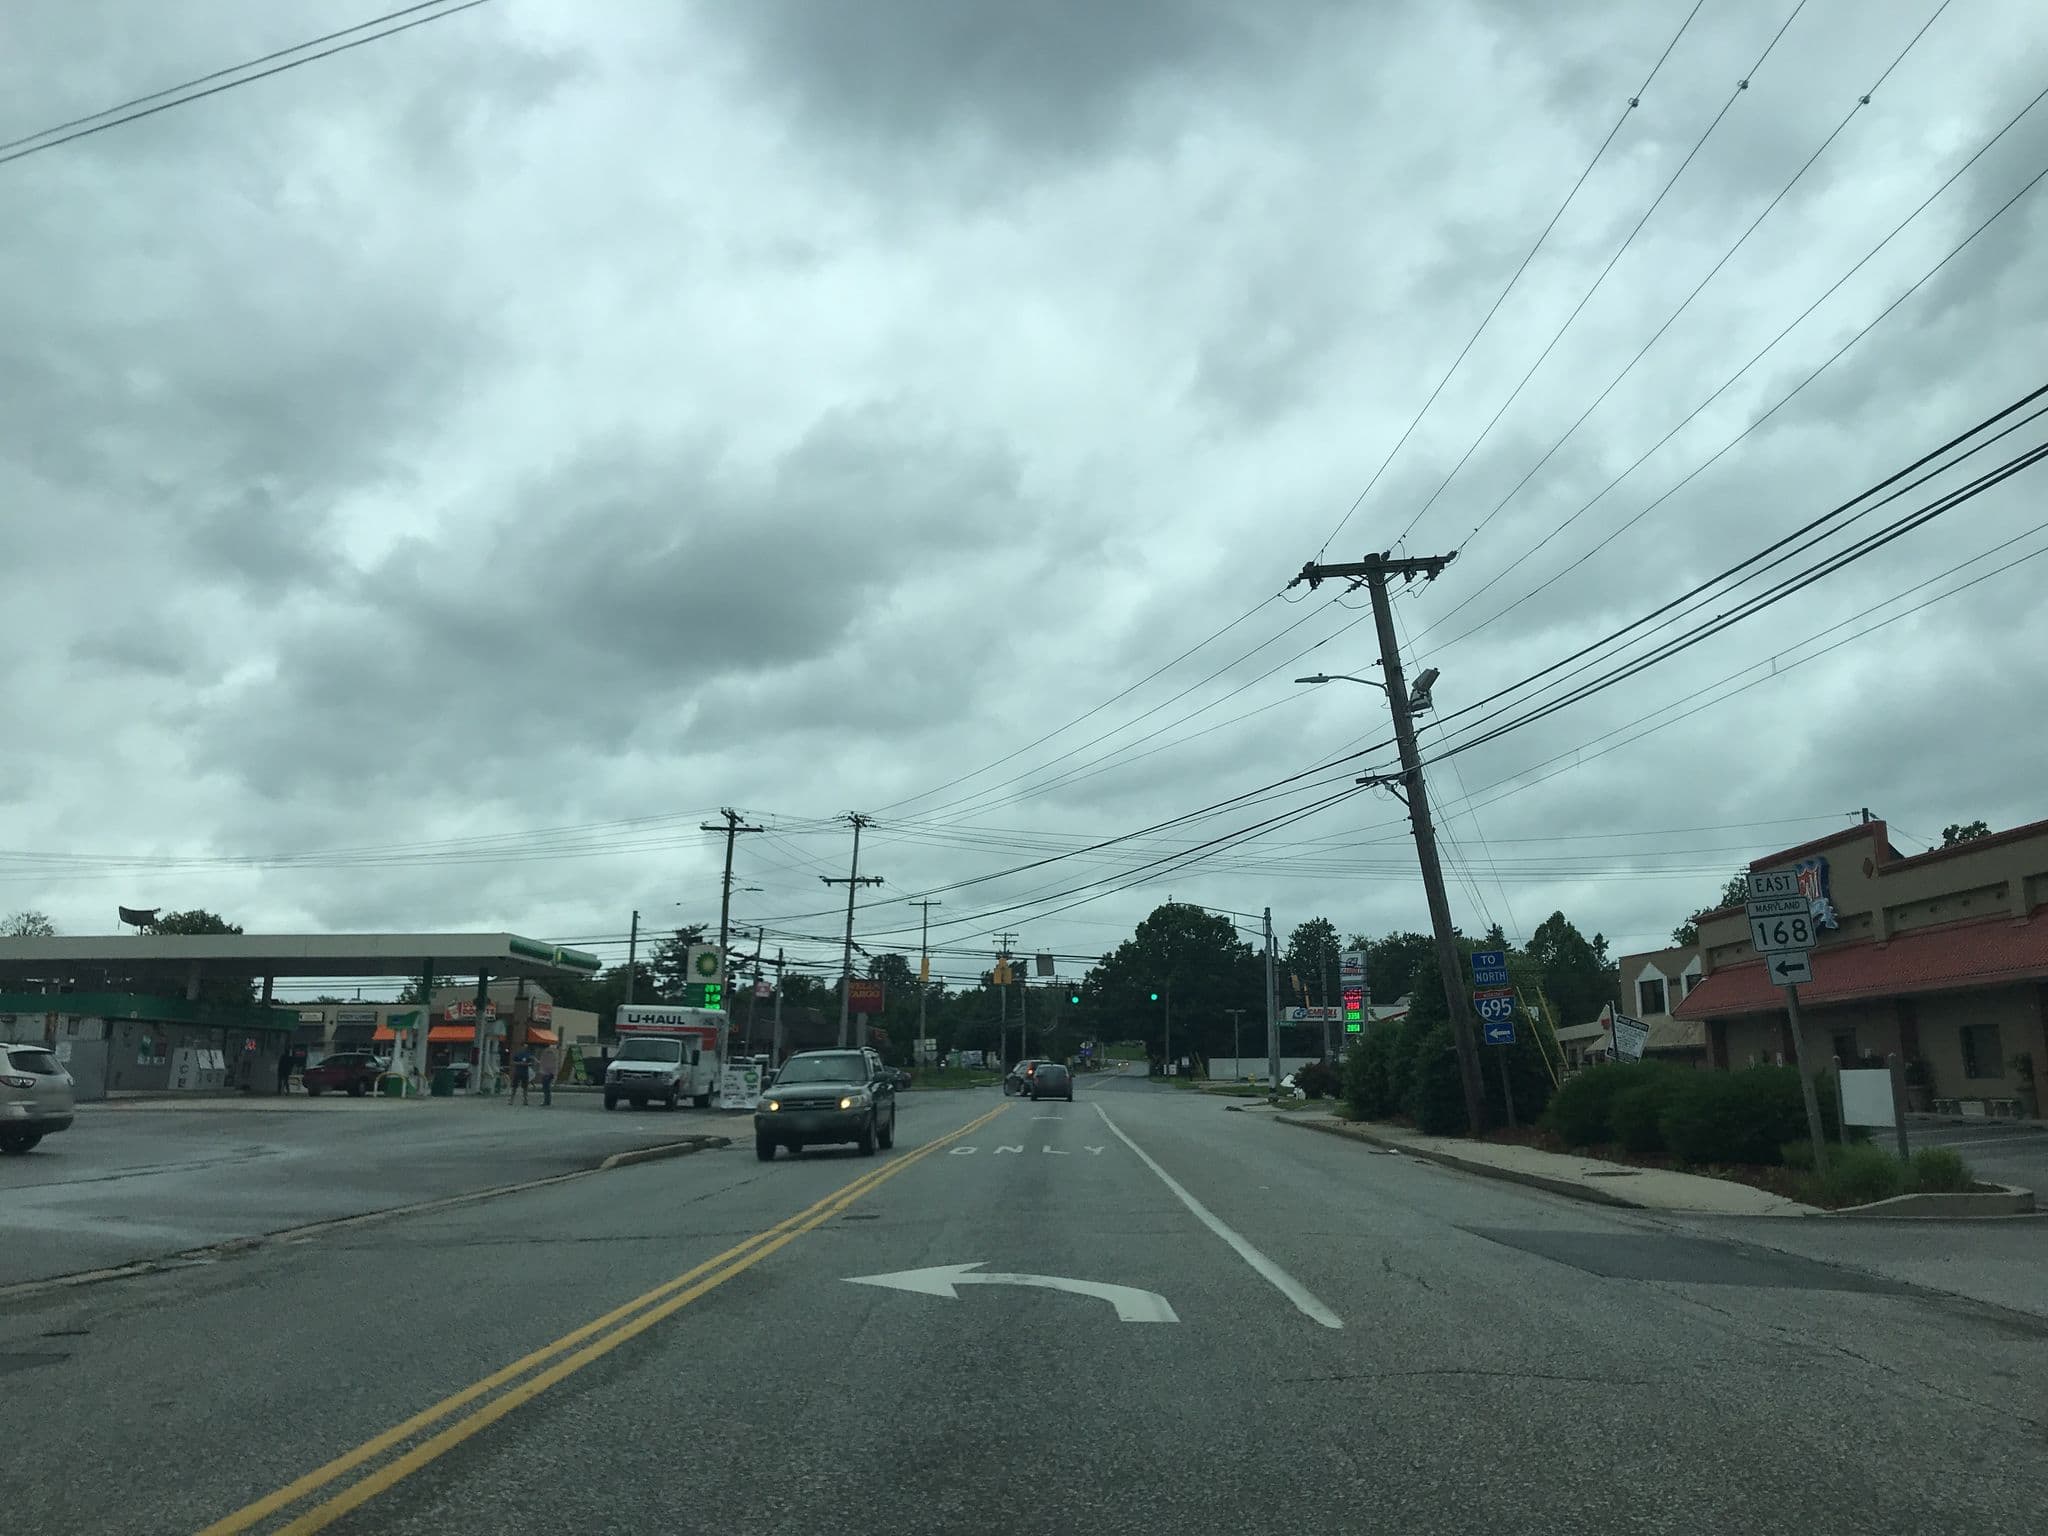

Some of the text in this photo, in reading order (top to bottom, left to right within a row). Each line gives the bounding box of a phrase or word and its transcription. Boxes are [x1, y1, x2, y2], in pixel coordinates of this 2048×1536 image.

[1755, 876, 1790, 892] EAST
[1755, 901, 1800, 912] MARYLAND
[1759, 919, 1808, 945] 168
[1480, 954, 1496, 965] TO
[1475, 971, 1506, 983] NORTH
[1481, 998, 1512, 1017] 695
[628, 1014, 685, 1025] U-HAUL
[947, 1145, 1104, 1156] ONLY
